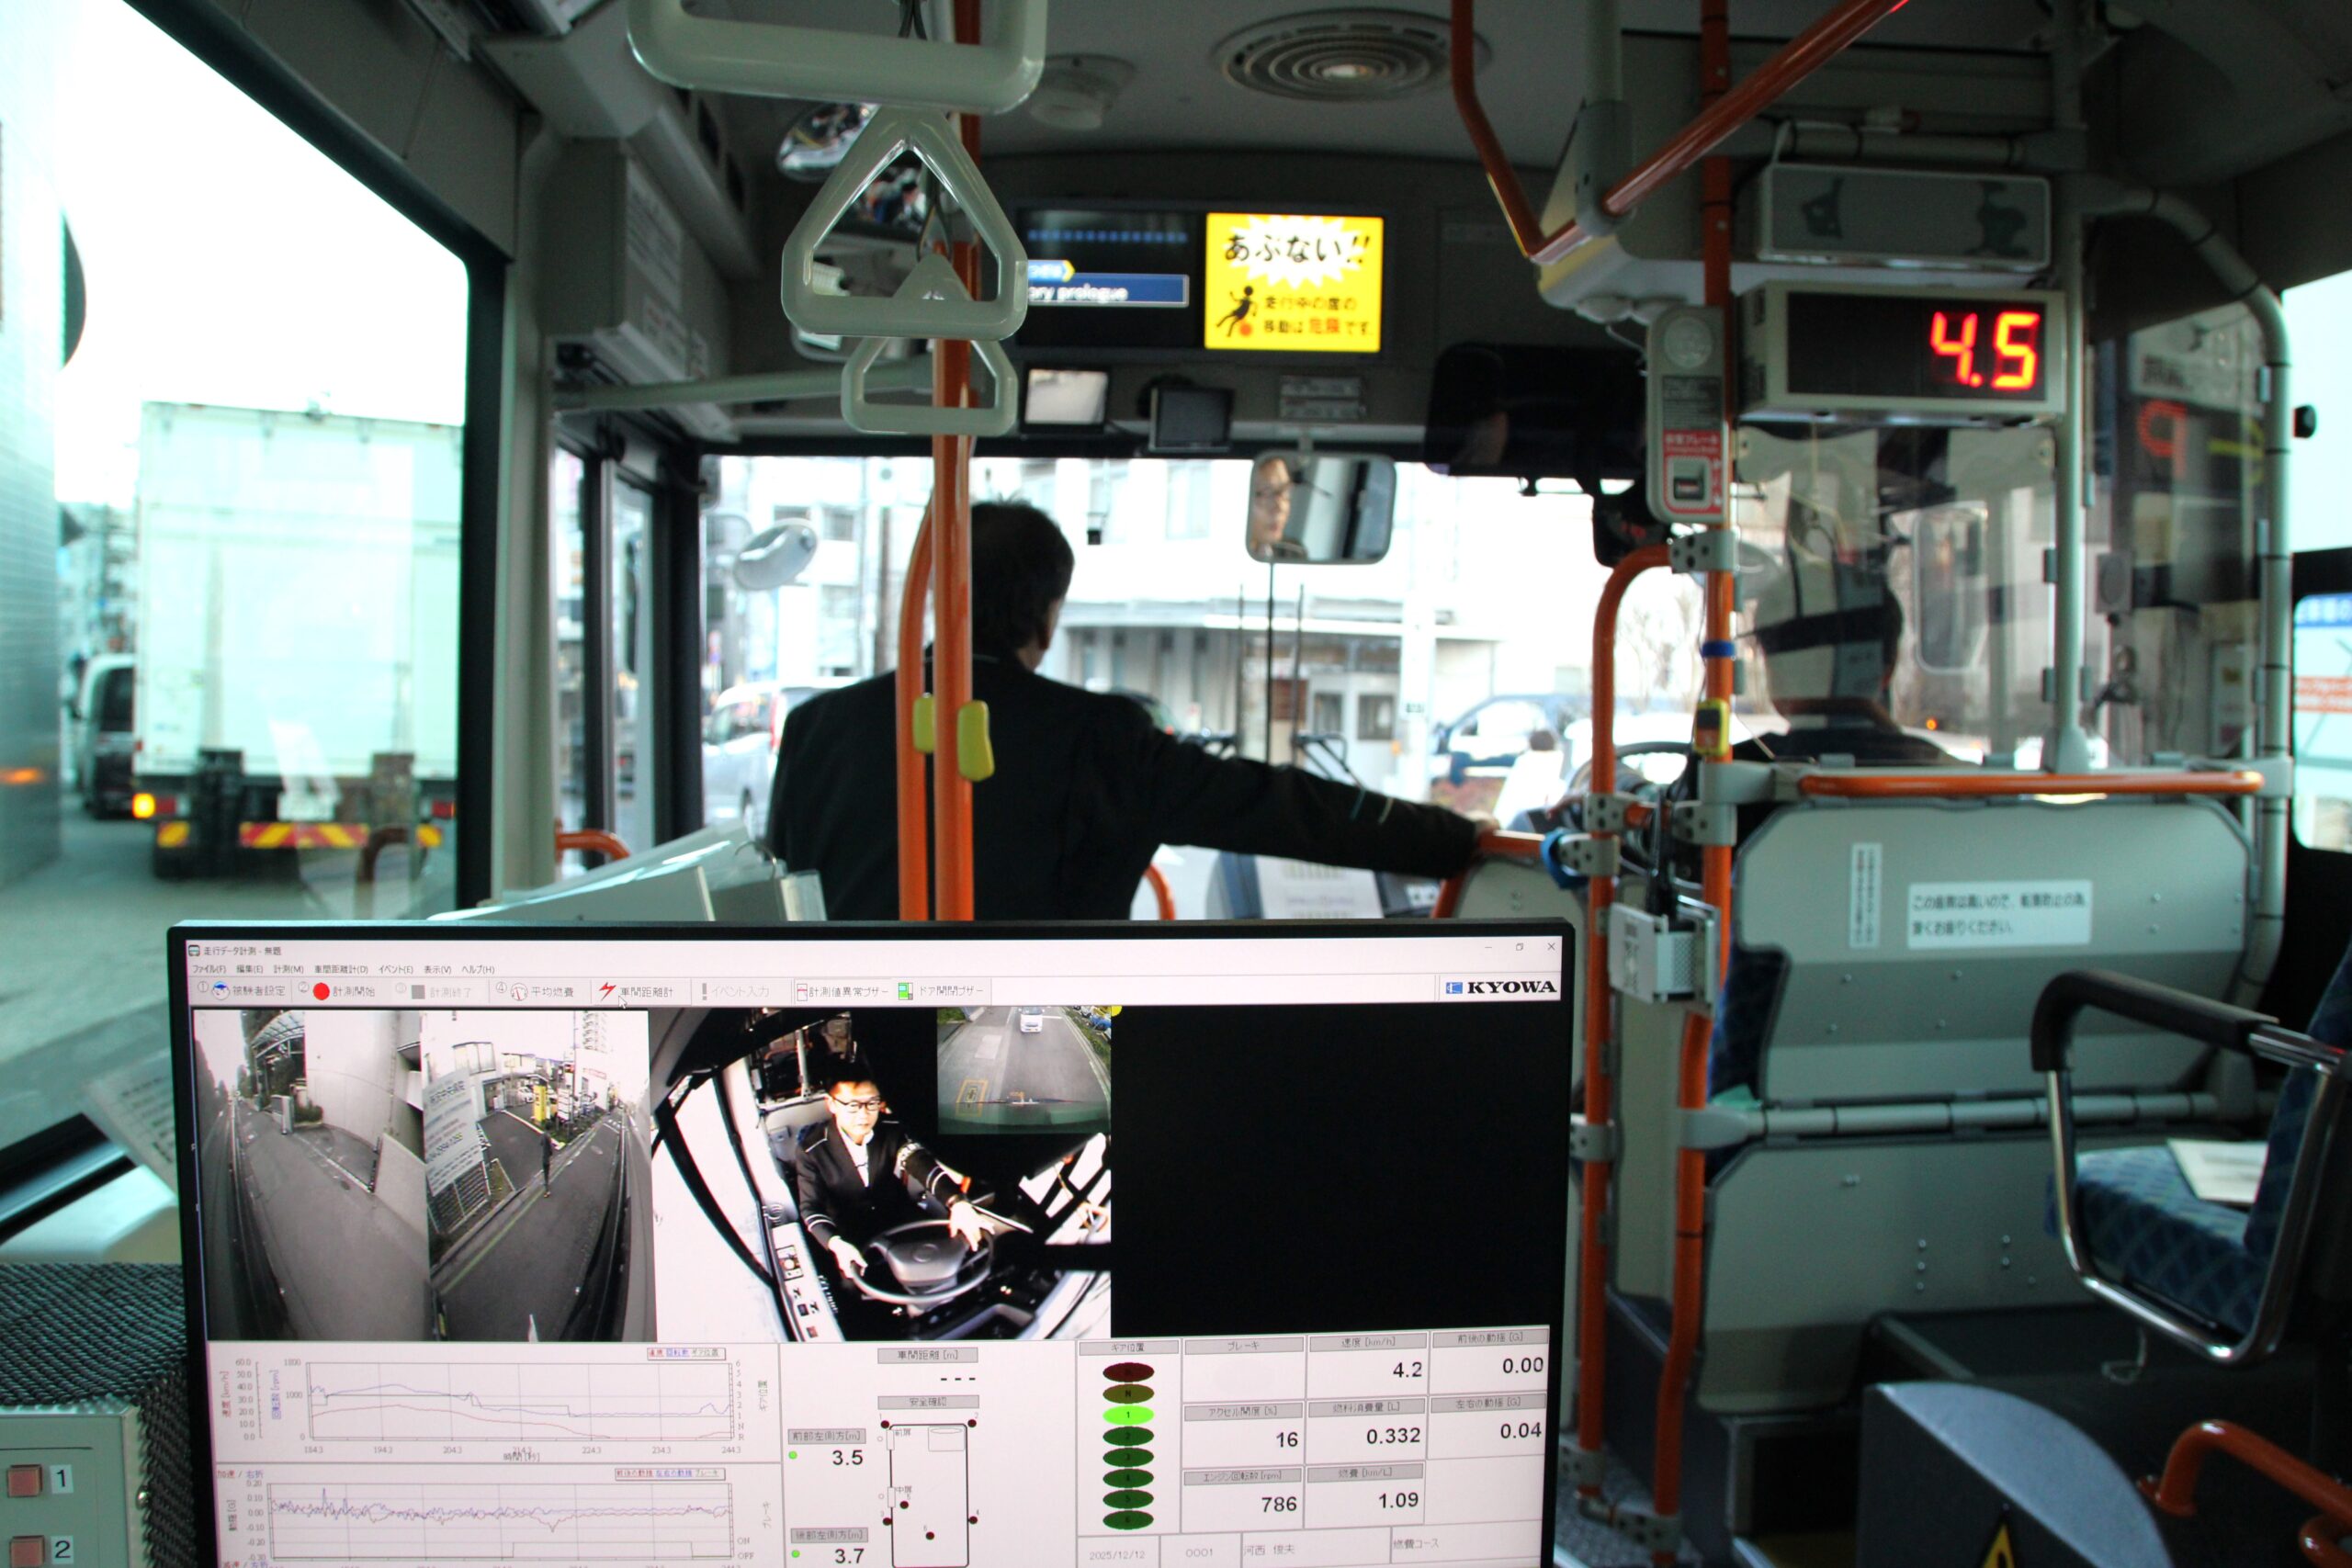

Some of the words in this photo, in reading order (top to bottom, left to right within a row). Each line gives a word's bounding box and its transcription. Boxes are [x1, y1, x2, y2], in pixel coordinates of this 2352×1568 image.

[1930, 310, 2041, 391] 4.5
[203, 945, 257, 956] 走行データ計測
[263, 946, 282, 956] 無題
[192, 964, 227, 975] ファイル(F)
[236, 964, 264, 975] 編集(E)
[273, 964, 304, 975] 計測(M)
[314, 964, 368, 975] 車間距離計(D)
[378, 964, 413, 975] イベント(E)
[424, 964, 452, 975] 表示(V)
[460, 964, 495, 975] ヘルプ(H)
[333, 986, 376, 998] 計測開始
[531, 986, 574, 998] 平均燃費
[619, 986, 673, 998] 車間距離計
[1467, 980, 1557, 995] KYOWA
[1393, 1361, 1422, 1378] 4.2
[1503, 1357, 1544, 1374] 0.00
[1366, 1427, 1421, 1445] 0.332
[1500, 1422, 1543, 1438] 0.04
[1276, 1432, 1299, 1448] 16
[832, 1450, 864, 1466] 3.5
[57, 1470, 66, 1487] 1
[1261, 1496, 1297, 1513] 786
[1378, 1492, 1419, 1509] 1.09
[55, 1540, 71, 1559] 2
[834, 1549, 865, 1563] 3.7
[1089, 1551, 1146, 1562] 2025/12/12
